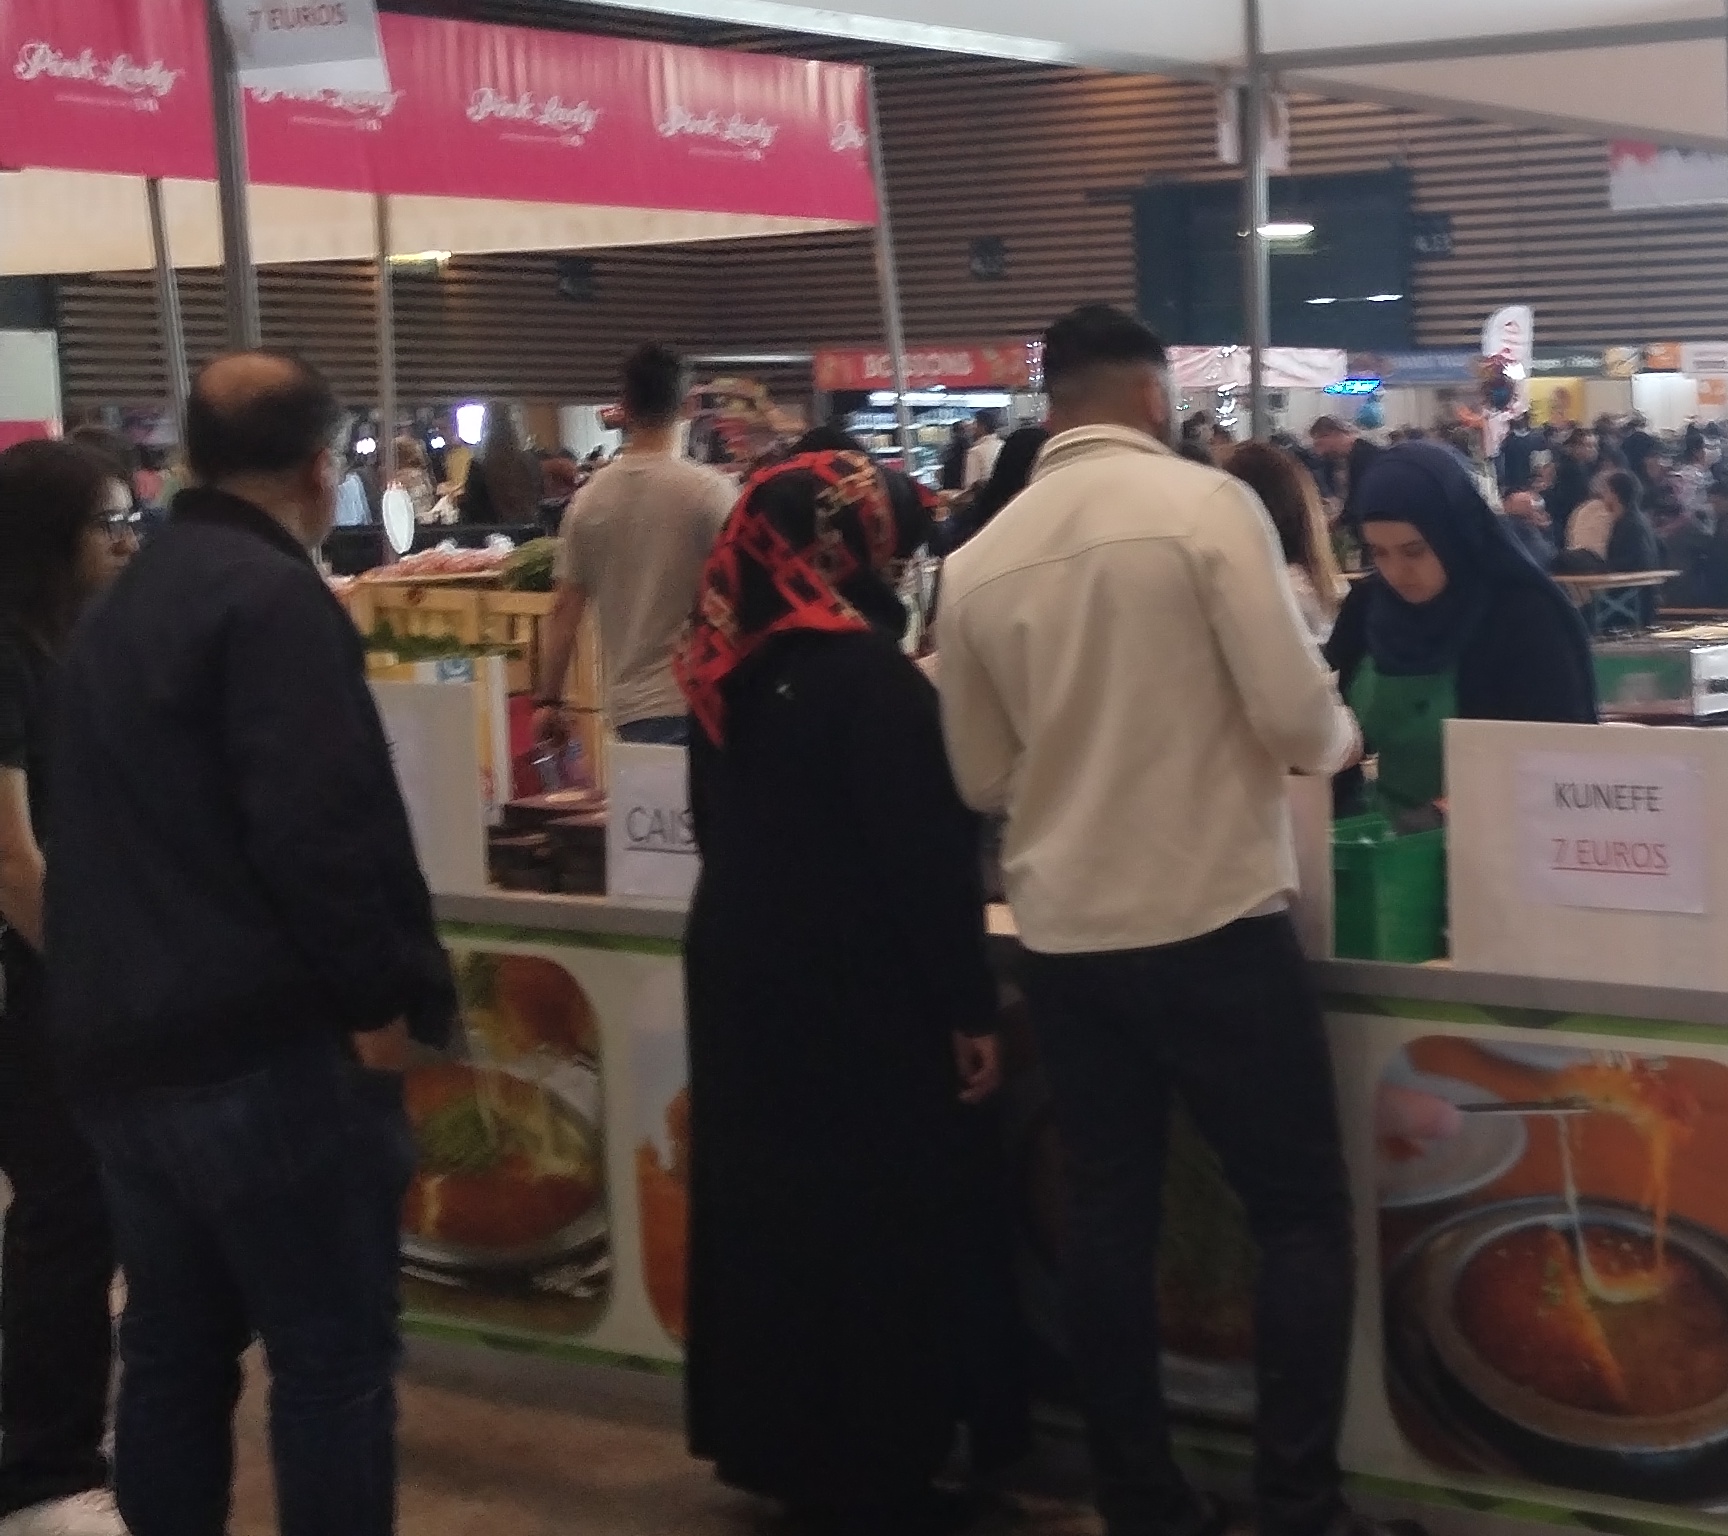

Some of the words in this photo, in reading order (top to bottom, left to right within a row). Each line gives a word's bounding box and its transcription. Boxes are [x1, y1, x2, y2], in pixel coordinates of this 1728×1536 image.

[268, 1, 347, 31] EUROS
[1554, 782, 1663, 812] KUNEFE
[625, 806, 697, 844] CAIS
[1551, 837, 1567, 864] 7
[1576, 838, 1669, 869] EUROS
